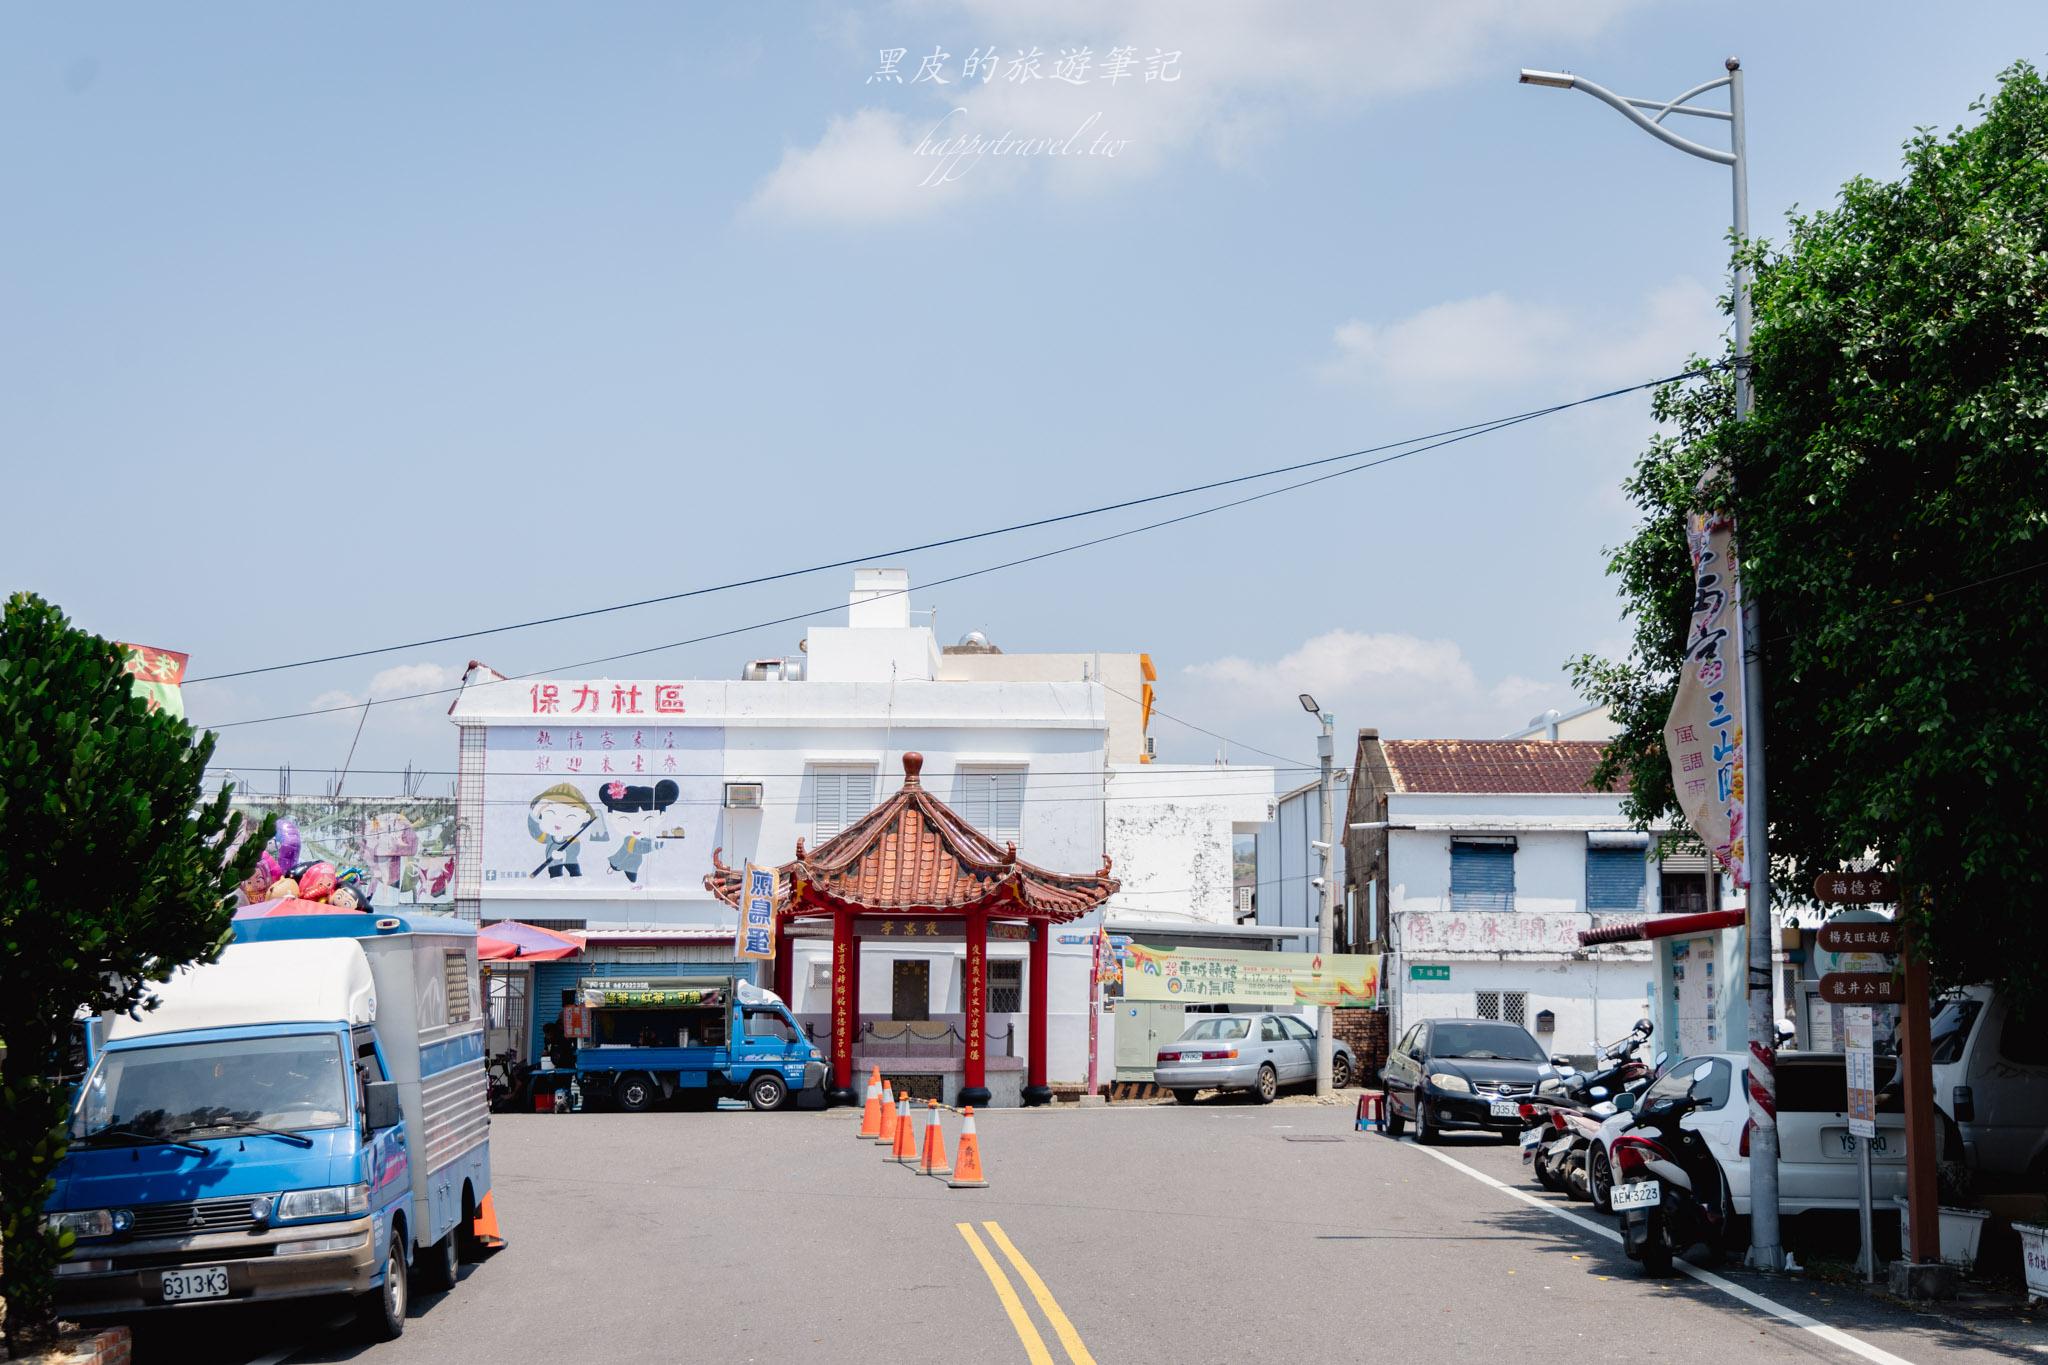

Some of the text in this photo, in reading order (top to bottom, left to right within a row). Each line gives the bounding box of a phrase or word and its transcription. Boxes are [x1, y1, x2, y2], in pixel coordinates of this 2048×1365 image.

[530, 683, 686, 714] 保力社區
[1831, 879, 1883, 896] 福德宮
[1829, 930, 1891, 945] 楊友旺故居
[1832, 980, 1891, 996] 龍井公園
[163, 1272, 228, 1296] 6313-K3
